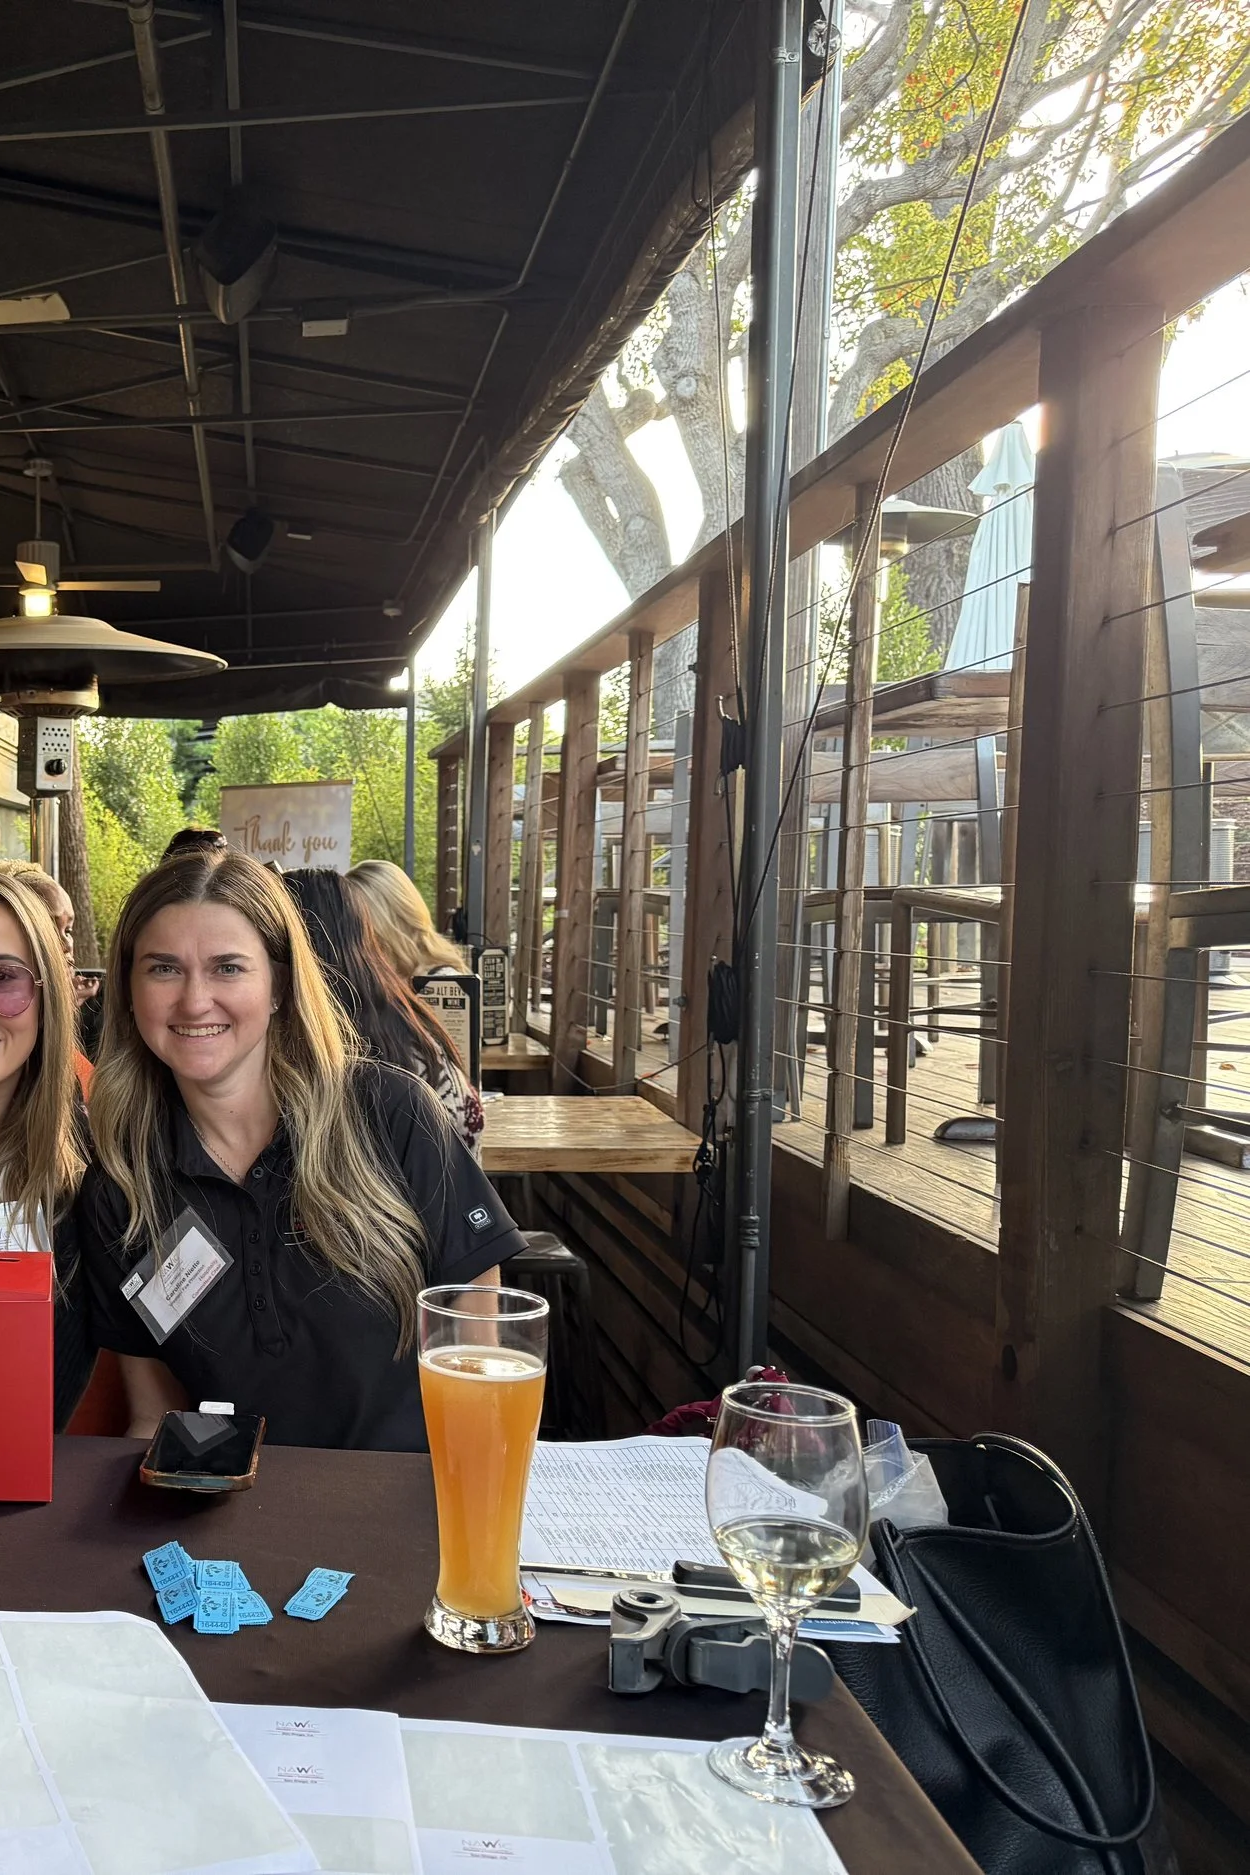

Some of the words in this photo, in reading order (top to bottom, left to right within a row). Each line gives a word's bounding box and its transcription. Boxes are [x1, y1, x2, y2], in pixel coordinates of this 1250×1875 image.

[234, 814, 296, 856] Thank
[302, 834, 337, 863] you
[436, 987, 448, 996] ALT
